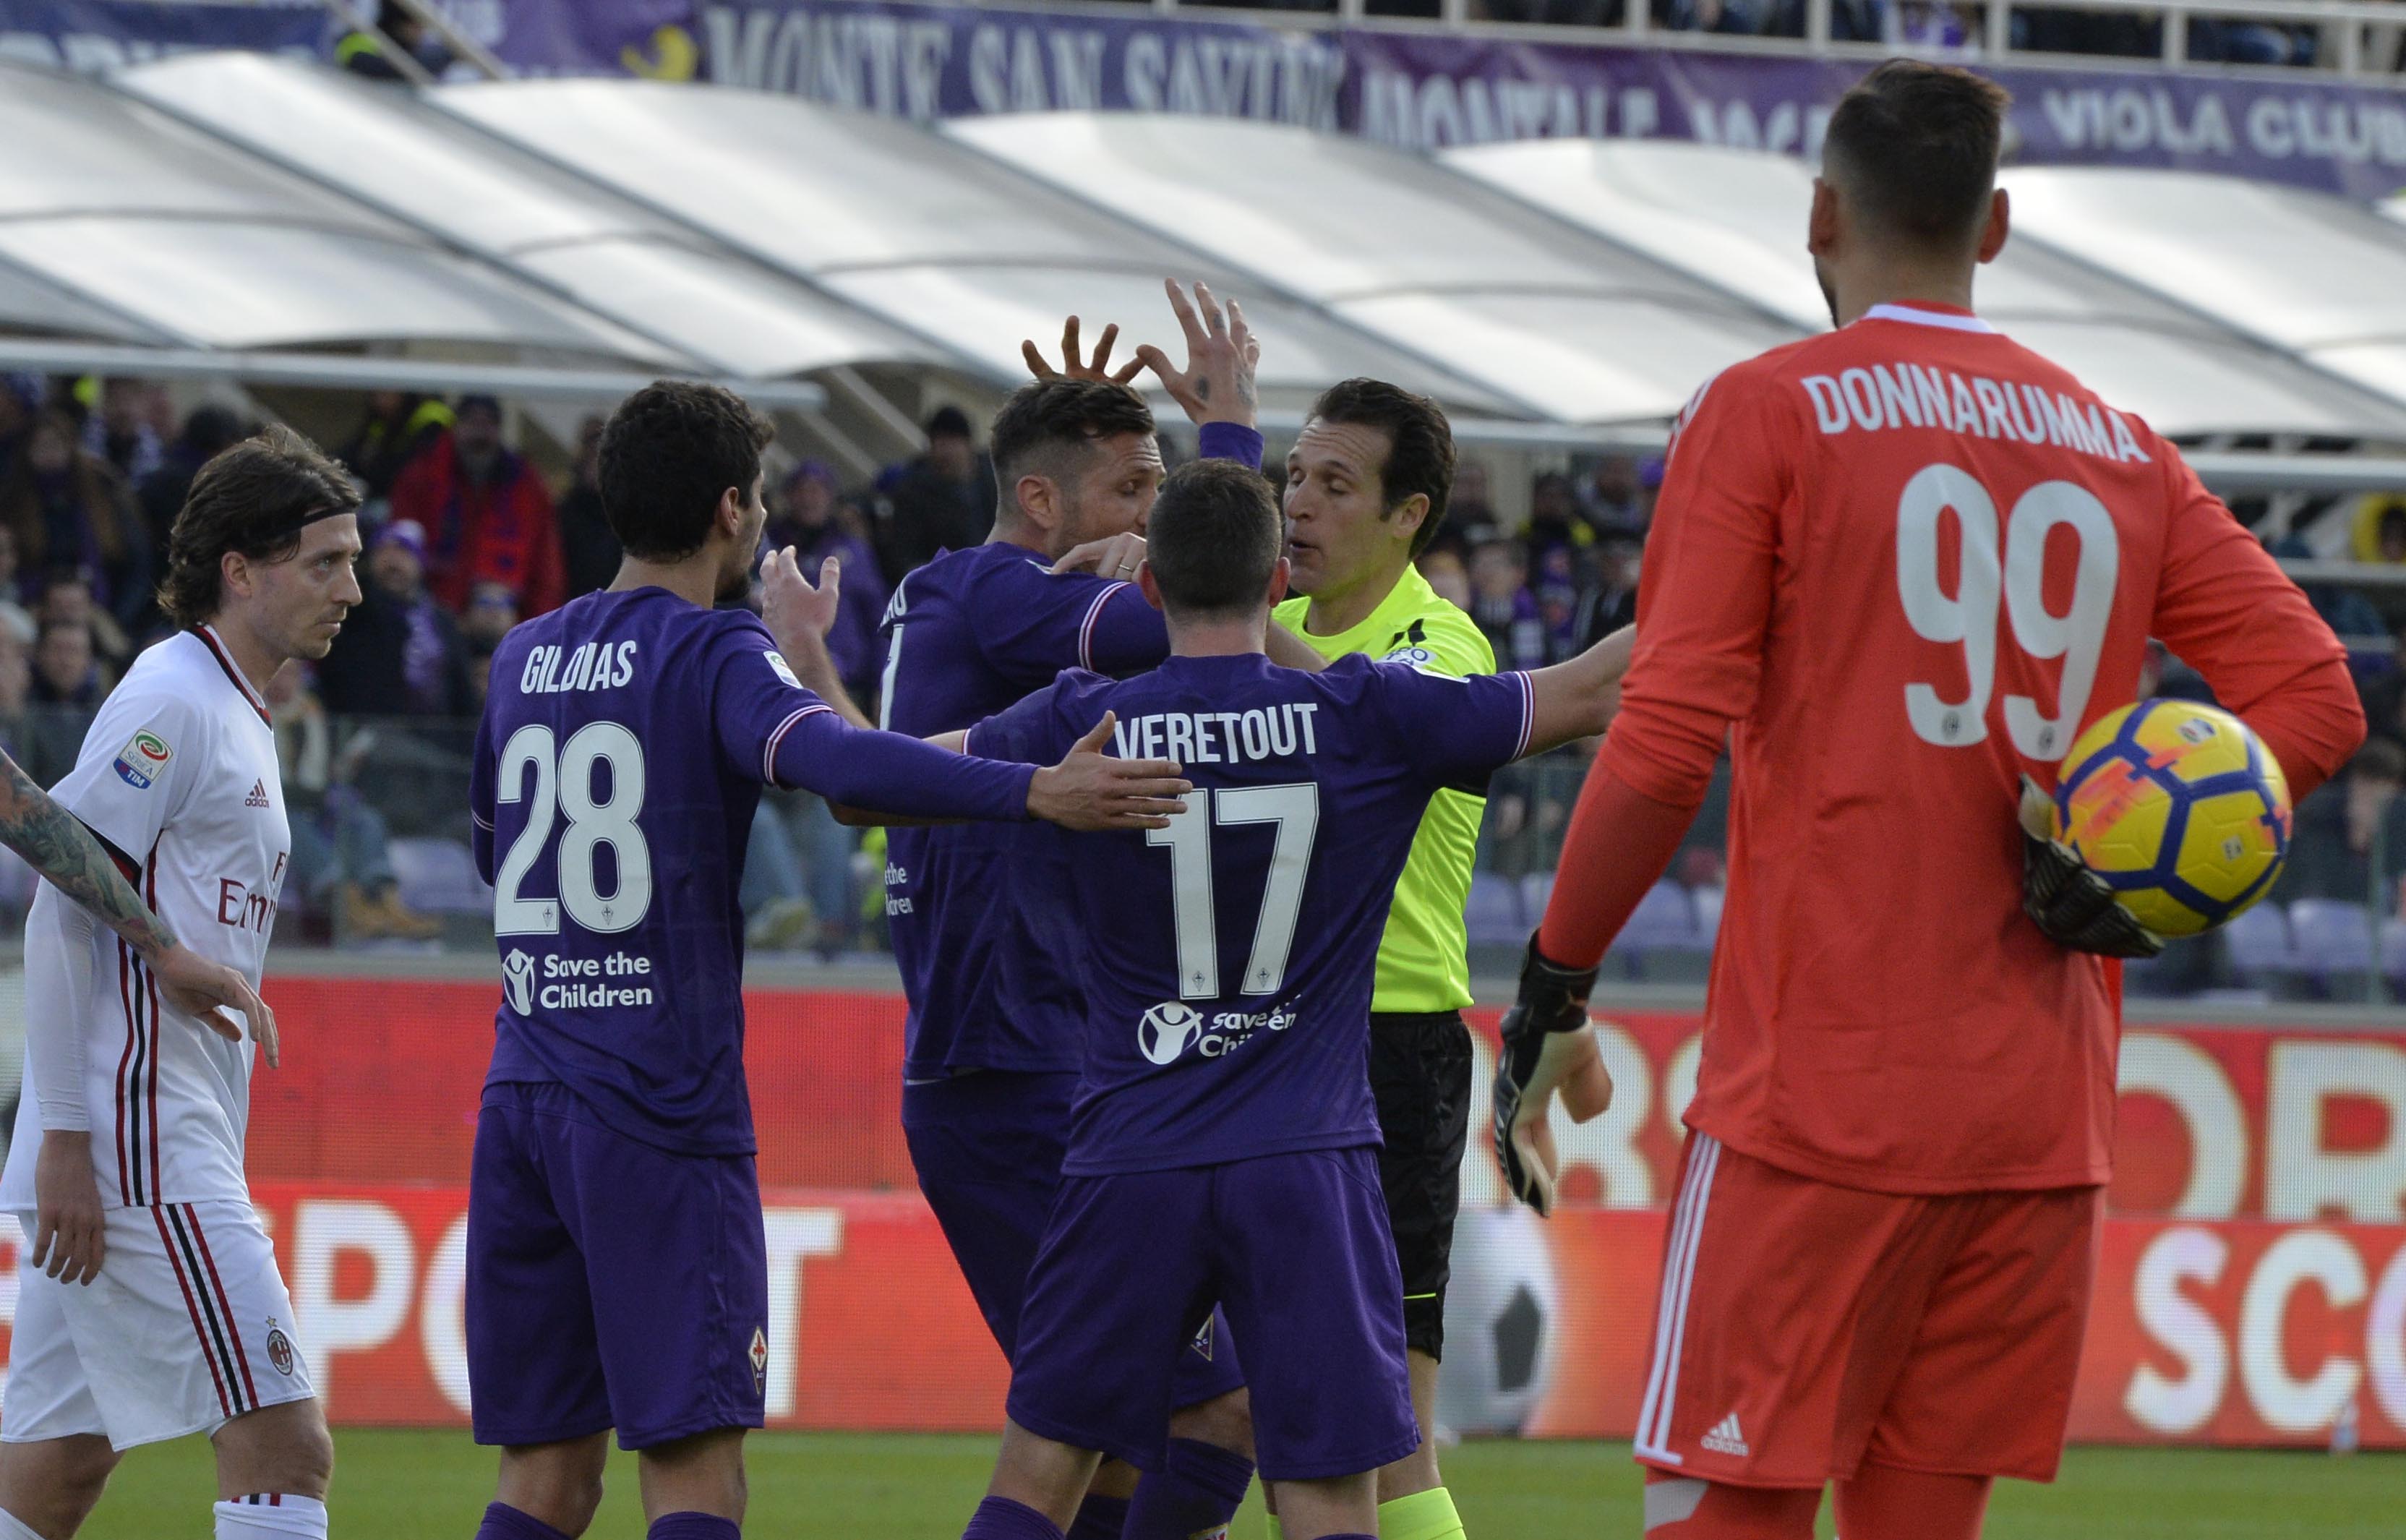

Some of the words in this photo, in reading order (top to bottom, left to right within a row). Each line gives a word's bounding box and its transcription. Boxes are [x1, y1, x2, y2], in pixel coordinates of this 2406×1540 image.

[969, 23, 1108, 114] SAN
[2041, 85, 2235, 159] VIOLA
[2246, 94, 2406, 166] CLUB
[1801, 362, 2153, 463] DONNARUMMA
[1895, 463, 2120, 761] 99
[1115, 702, 1318, 765] VERETOUT
[495, 721, 651, 936] 28
[1146, 781, 1319, 1000] 17
[540, 983, 653, 1009] Children
[544, 954, 599, 978] Save
[604, 951, 650, 975] the
